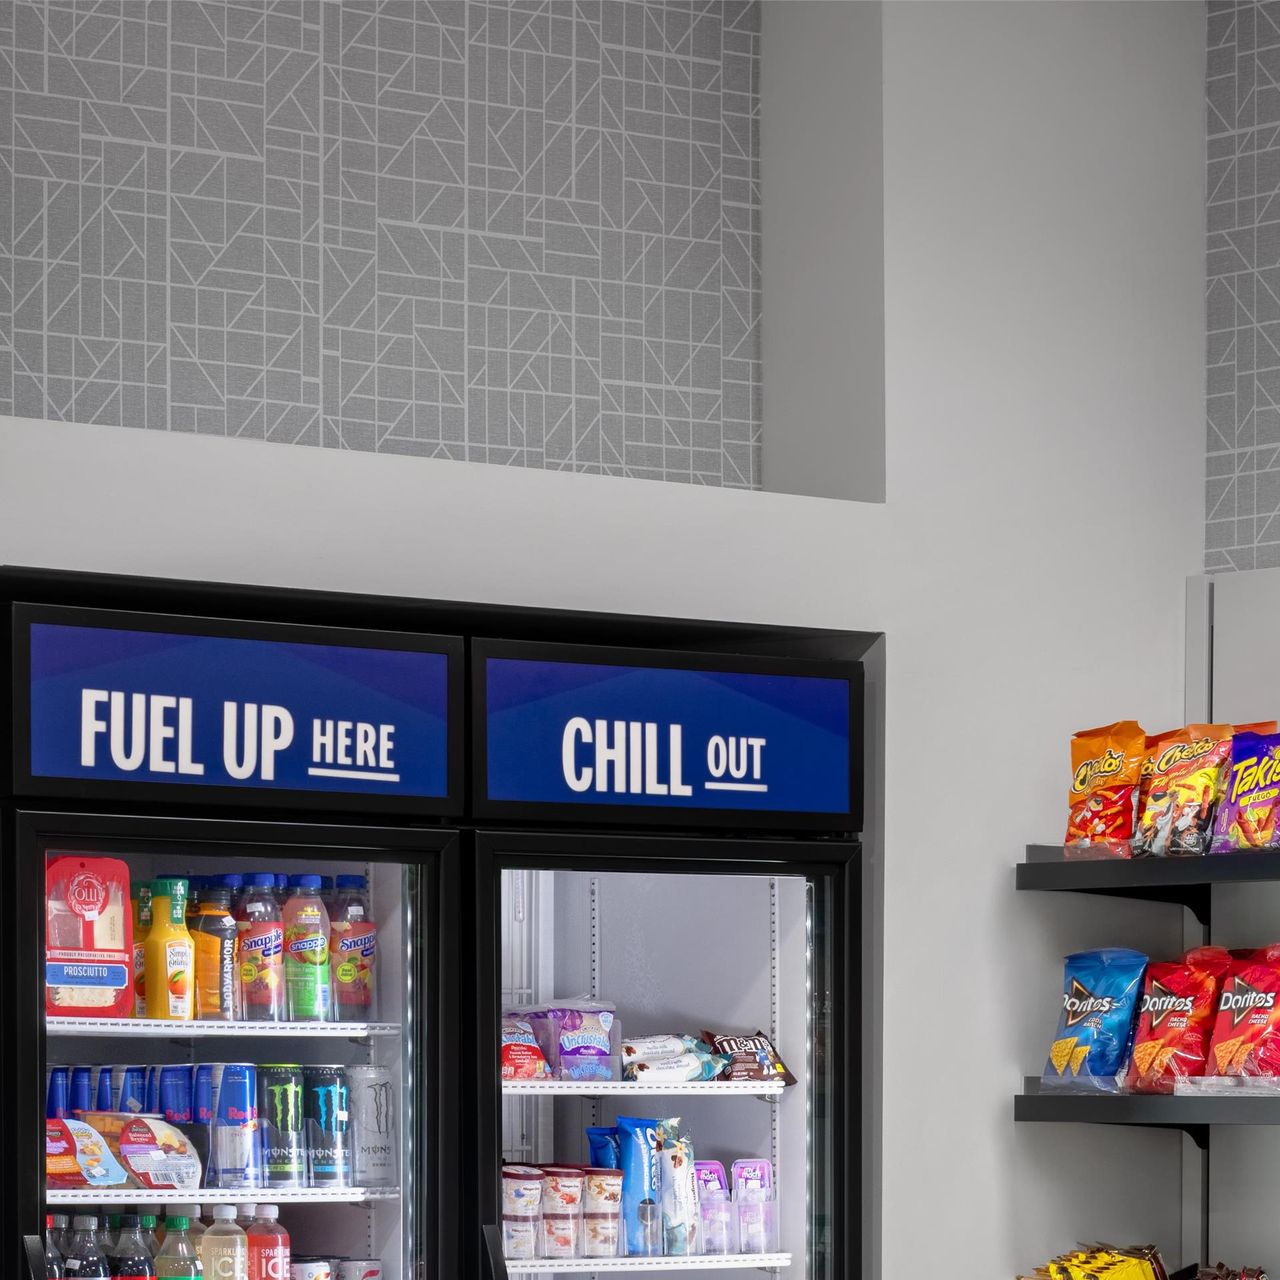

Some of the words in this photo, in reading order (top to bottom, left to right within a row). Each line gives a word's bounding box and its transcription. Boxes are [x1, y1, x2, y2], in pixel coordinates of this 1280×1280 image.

[80, 688, 204, 775] FUEL
[223, 700, 294, 781] UP
[313, 718, 396, 770] HERE
[561, 717, 692, 797] CHILL
[708, 735, 766, 780] OUT
[1155, 737, 1219, 774] Cheetos
[1247, 791, 1272, 803] FUEGO
[241, 928, 283, 951] Snapple
[63, 965, 108, 978] PROSCIUTTO
[1140, 994, 1195, 1014] Doritos
[1220, 991, 1276, 1011] Doritos
[261, 1256, 291, 1278] ICE
